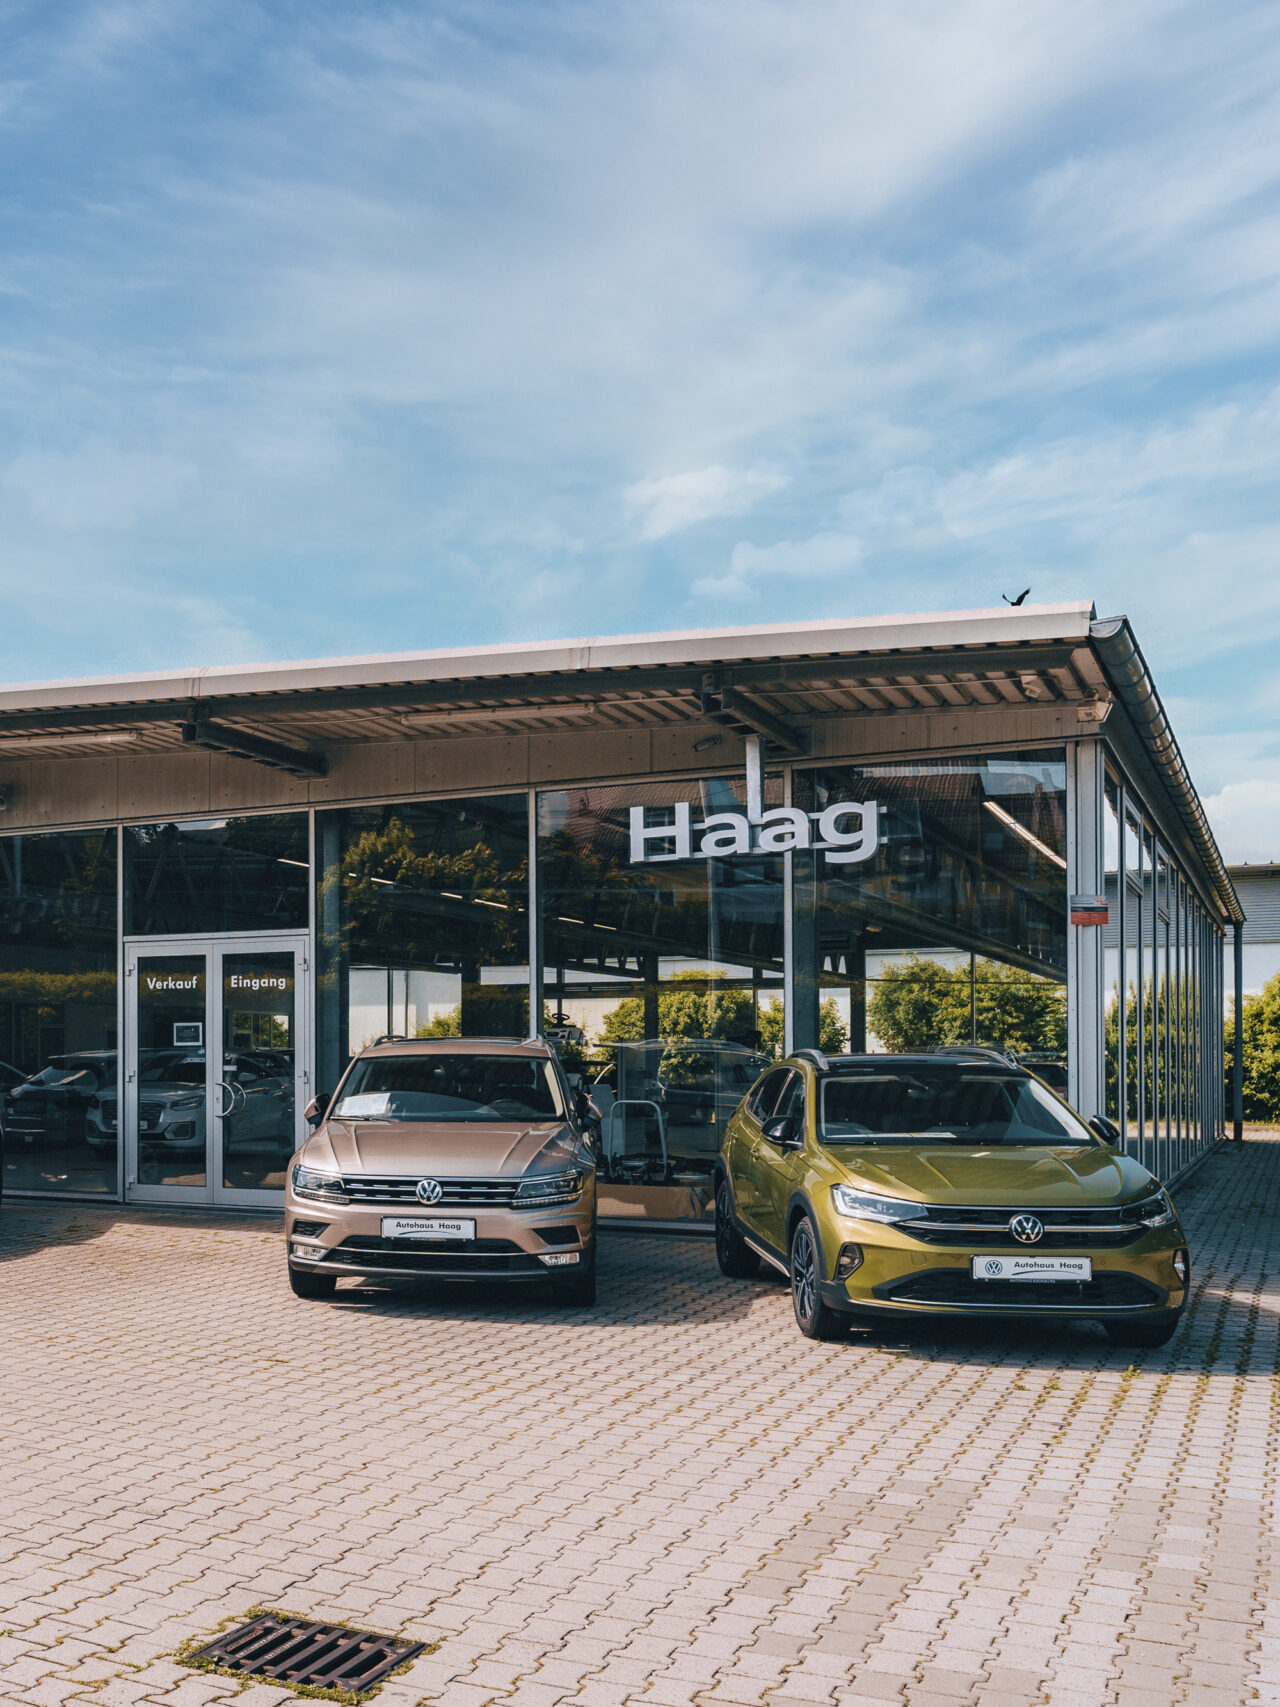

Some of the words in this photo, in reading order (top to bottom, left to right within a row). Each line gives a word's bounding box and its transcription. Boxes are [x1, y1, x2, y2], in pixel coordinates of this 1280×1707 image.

[629, 800, 878, 864] Haag
[147, 976, 198, 990] Verkauf
[231, 975, 287, 991] Eingang
[438, 1222, 462, 1231] Haag
[1014, 1261, 1055, 1269] Autohaus
[1059, 1262, 1083, 1270] Haag
